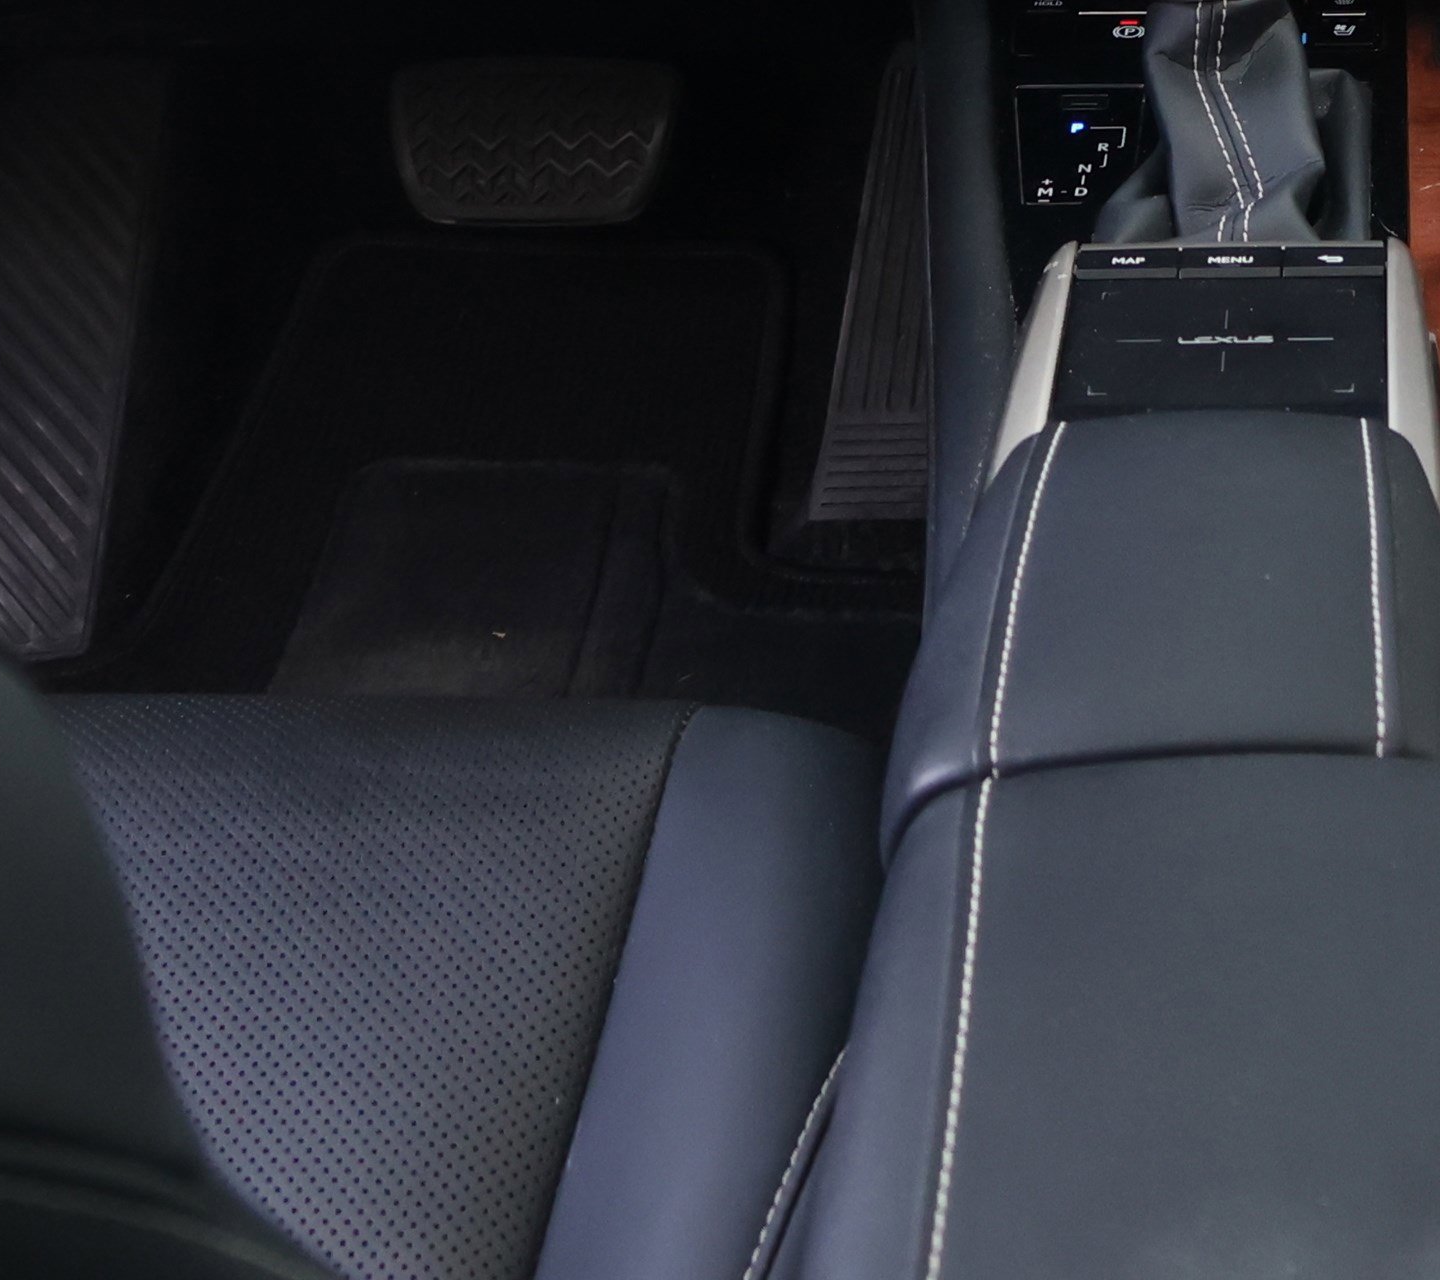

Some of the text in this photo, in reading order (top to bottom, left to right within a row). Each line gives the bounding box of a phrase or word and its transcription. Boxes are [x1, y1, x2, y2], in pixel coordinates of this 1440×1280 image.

[1070, 122, 1084, 134] P
[1097, 143, 1109, 152] R
[1078, 164, 1092, 173] N
[1037, 188, 1053, 197] M
[1074, 187, 1088, 197] D
[1111, 256, 1146, 265] MAP
[1207, 255, 1254, 264] MENU
[1178, 335, 1274, 344] LEXUS
